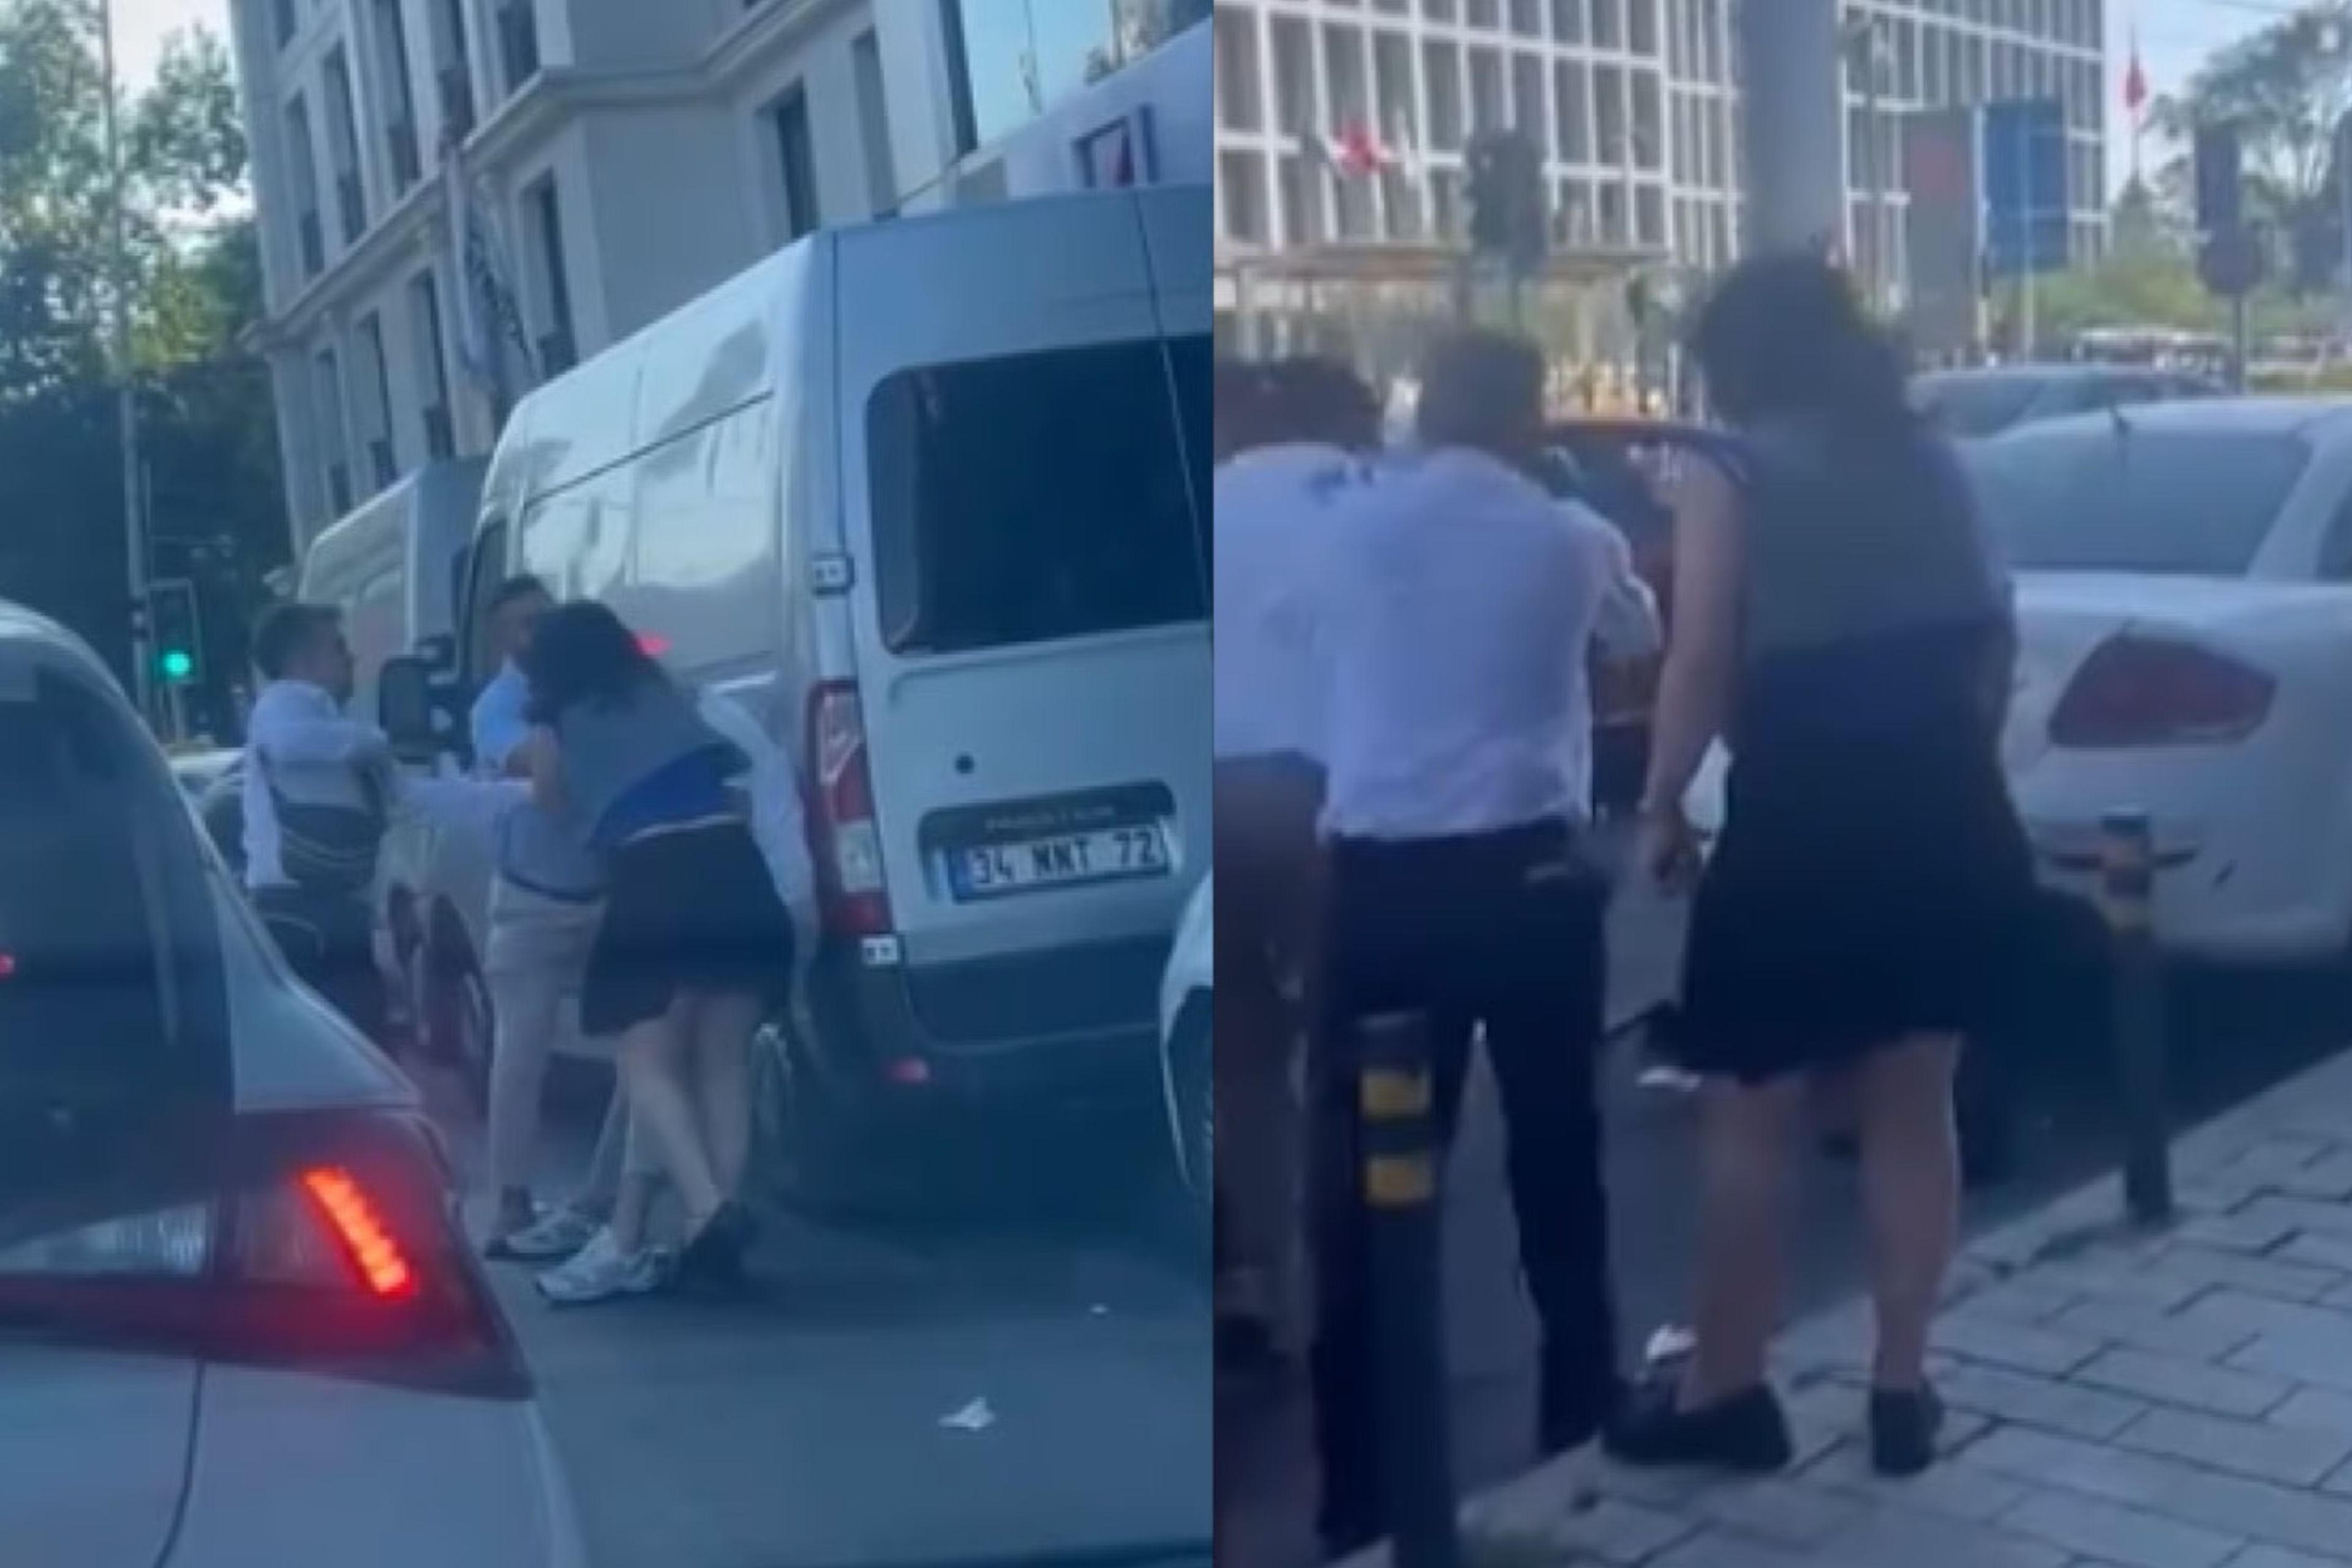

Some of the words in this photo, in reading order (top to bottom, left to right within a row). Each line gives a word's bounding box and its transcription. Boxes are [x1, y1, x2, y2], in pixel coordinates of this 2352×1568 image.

[973, 848, 1013, 884] 34
[1031, 836, 1088, 876] NNT
[1114, 831, 1157, 865] 72
